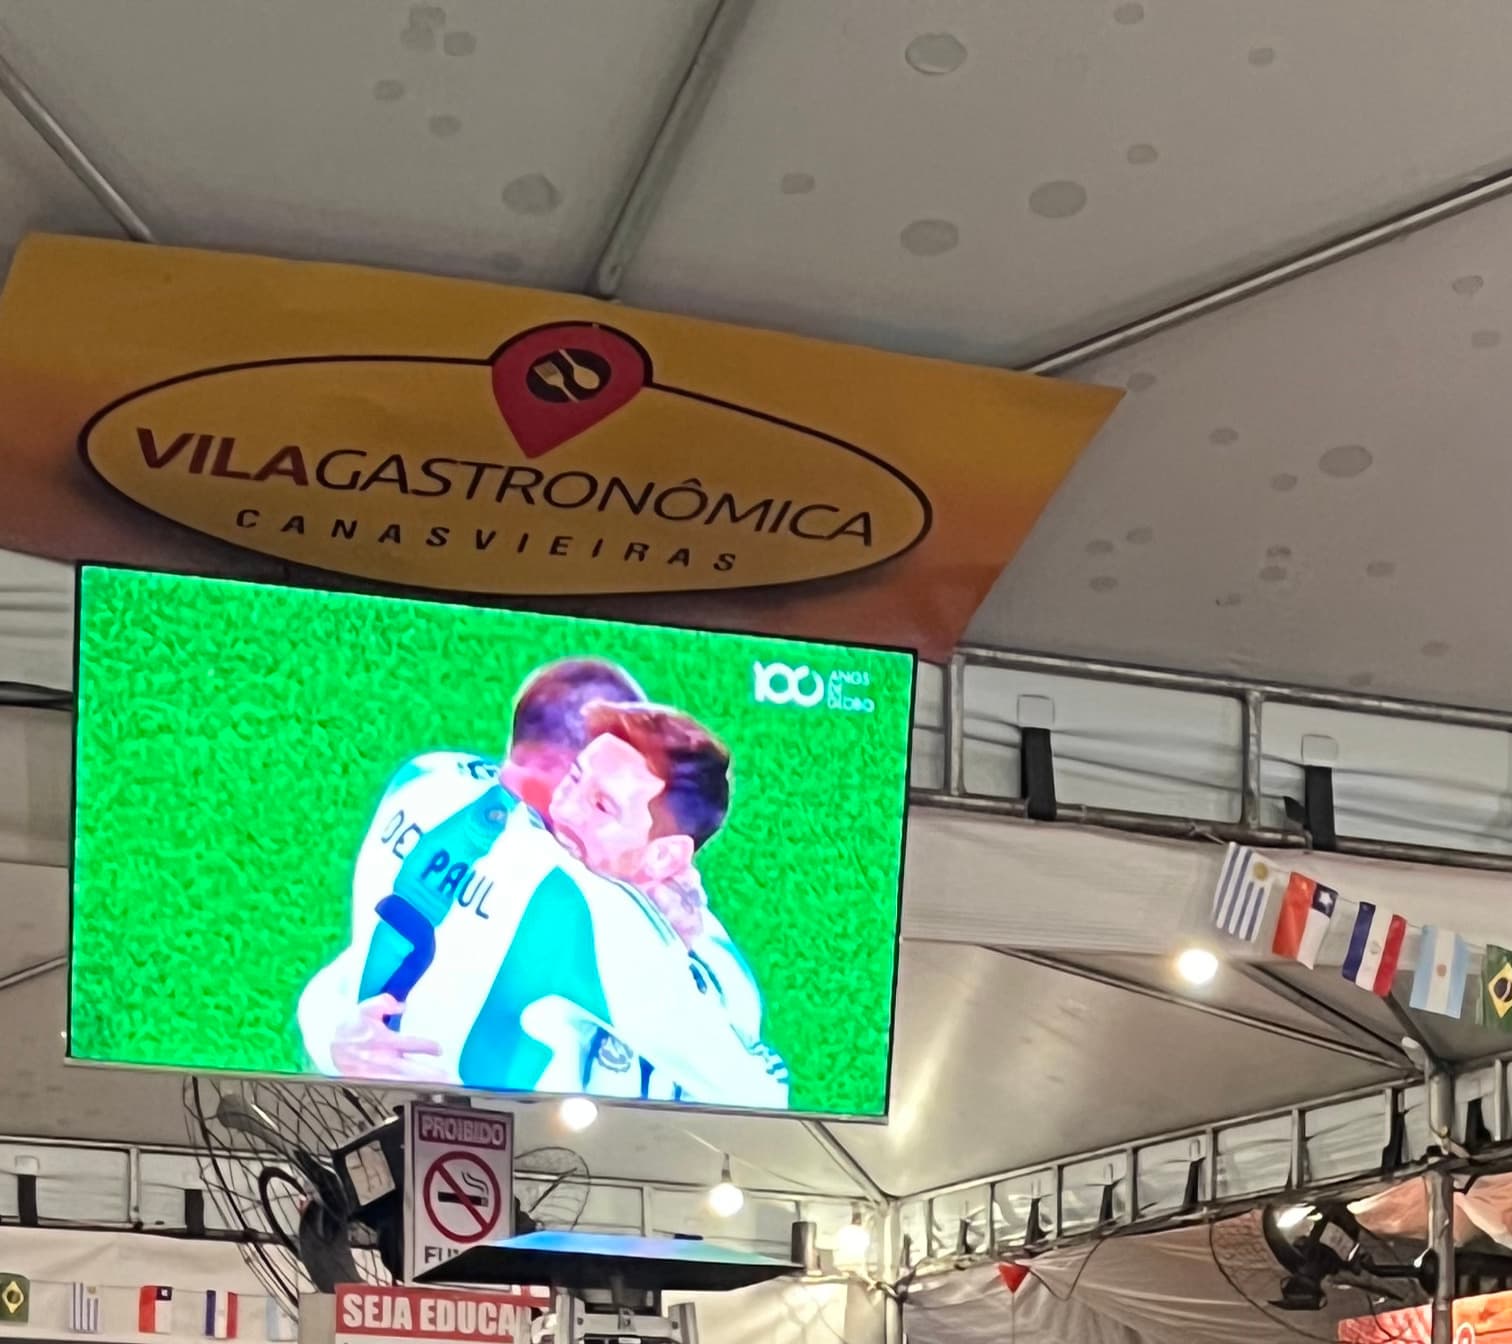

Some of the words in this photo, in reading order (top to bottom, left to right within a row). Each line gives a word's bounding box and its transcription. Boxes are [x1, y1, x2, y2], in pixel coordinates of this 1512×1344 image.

[236, 509, 736, 571] CANASVIEIRAS
[421, 848, 494, 919] PAUL
[421, 1115, 504, 1146] PROIBIDO
[343, 1293, 413, 1331] SEJA
[420, 1298, 517, 1336] EDUCA
